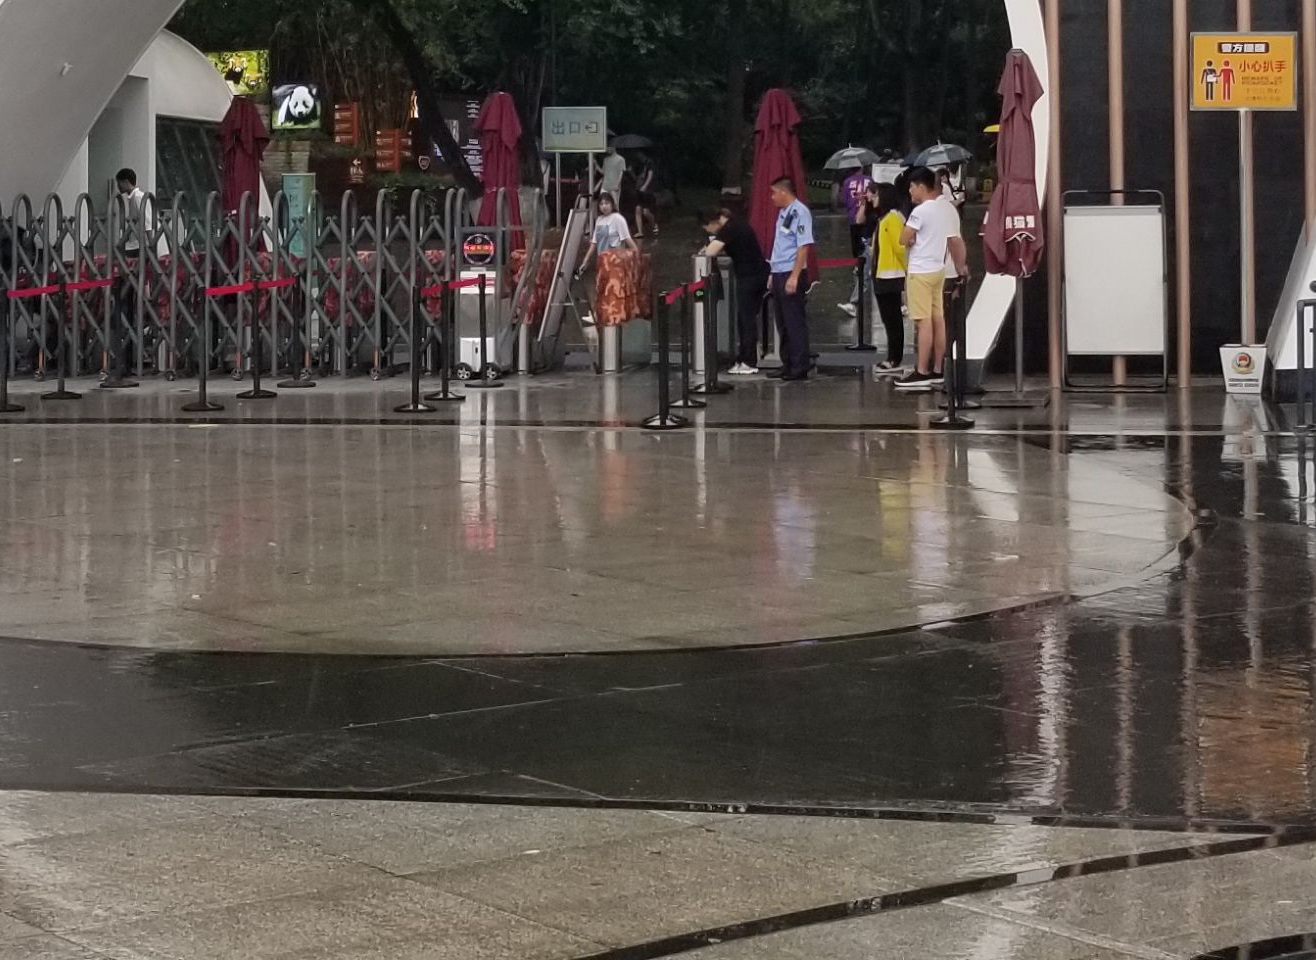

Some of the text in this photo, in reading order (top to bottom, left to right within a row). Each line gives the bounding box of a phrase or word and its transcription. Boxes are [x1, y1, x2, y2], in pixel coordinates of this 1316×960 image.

[1239, 60, 1287, 73] 小心扒手
[551, 120, 581, 135] 出口
